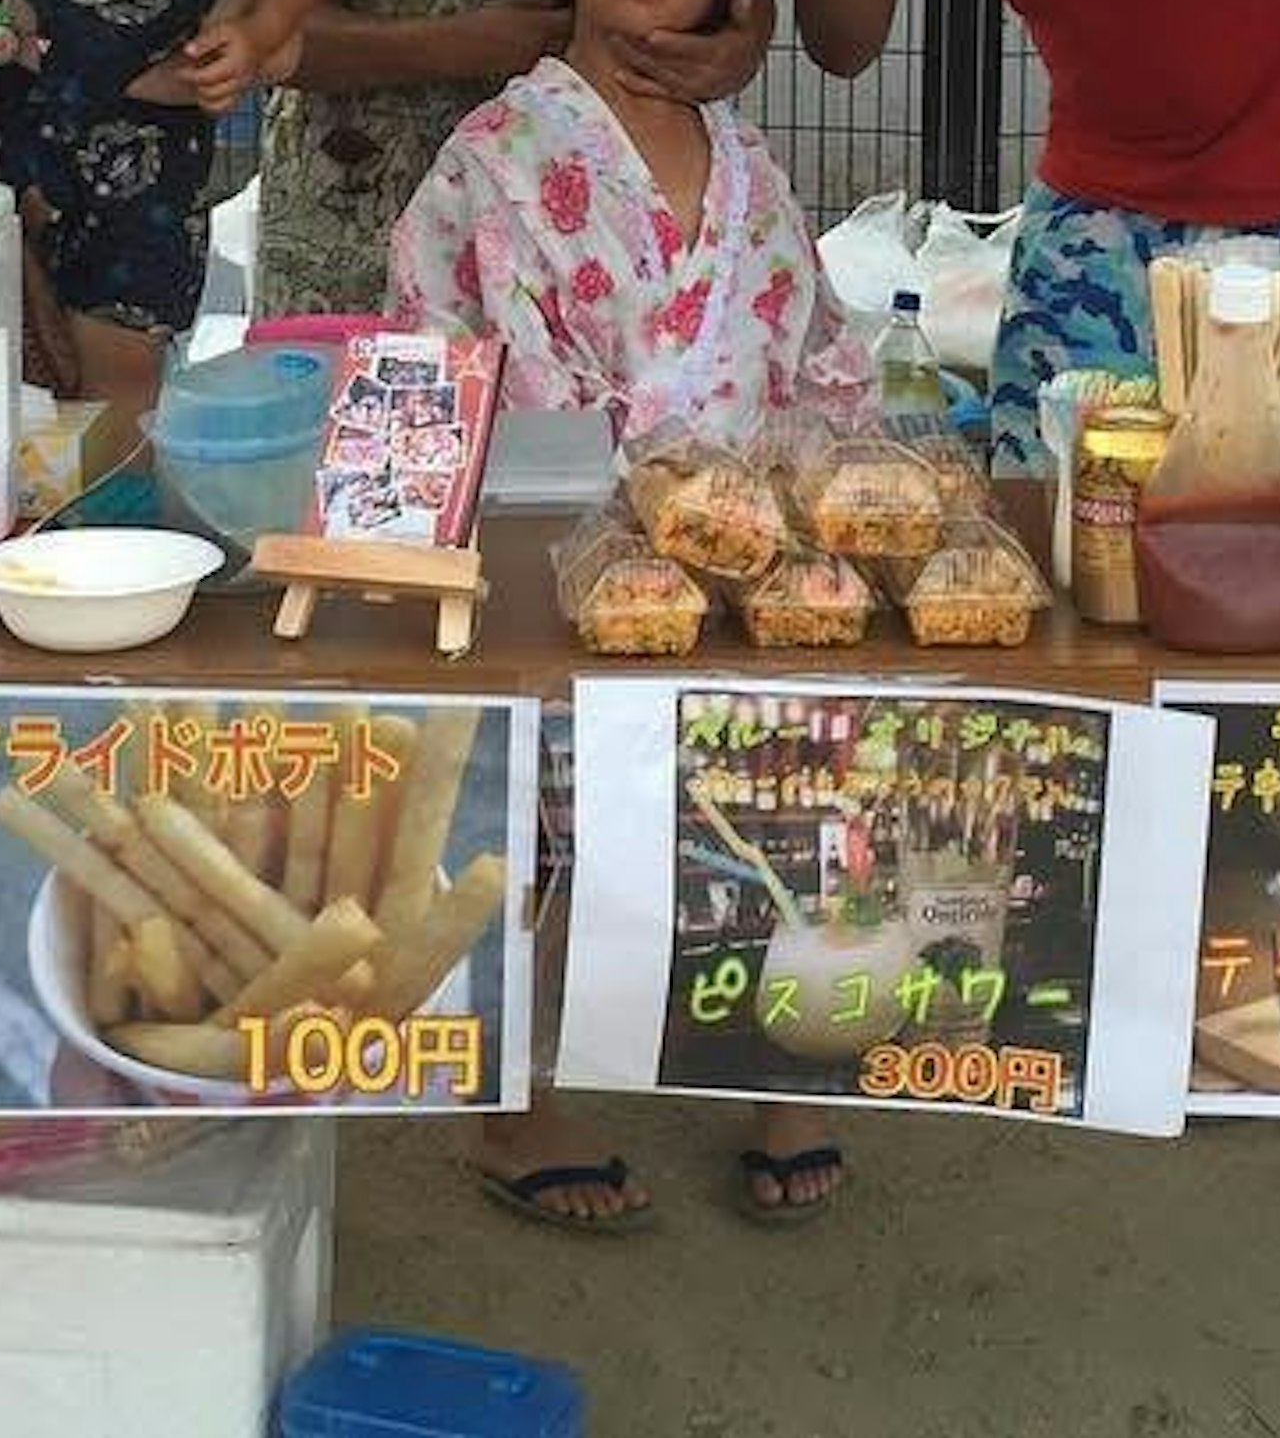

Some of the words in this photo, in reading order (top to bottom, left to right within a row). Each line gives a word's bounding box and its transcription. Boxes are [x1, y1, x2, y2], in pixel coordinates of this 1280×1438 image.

[690, 956, 1074, 1026] ピスコサワー
[236, 1012, 486, 1098] 100円
[856, 1042, 1064, 1114] 300円
